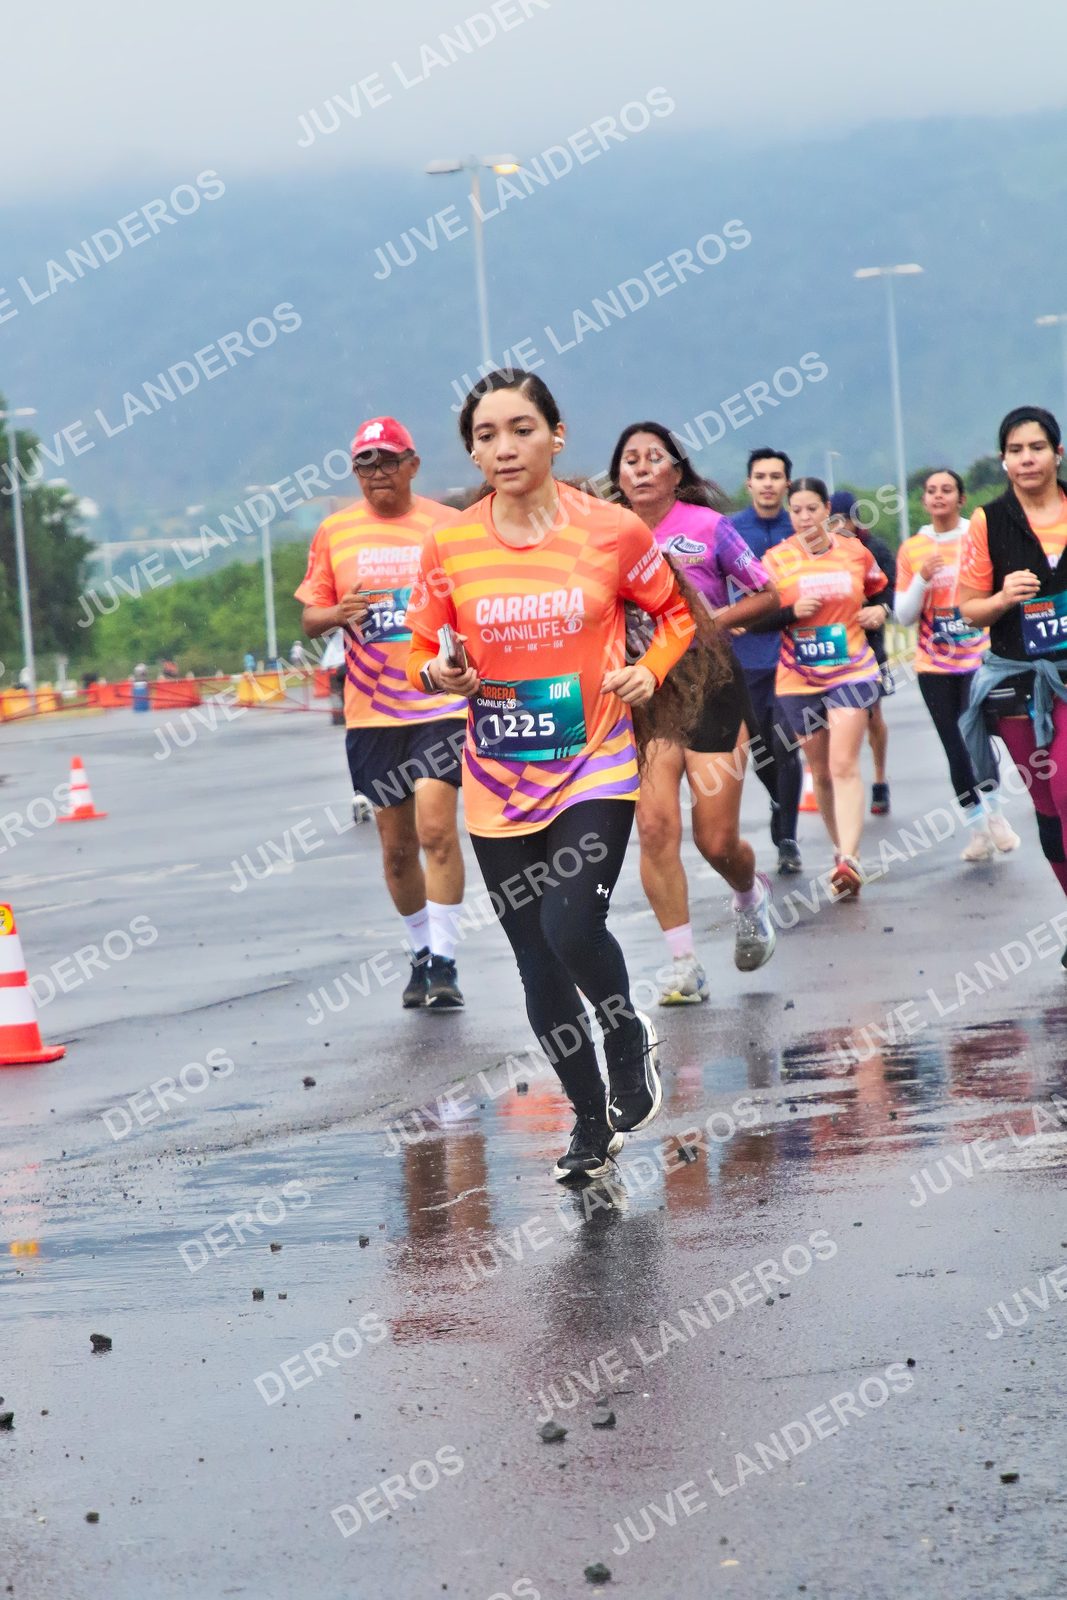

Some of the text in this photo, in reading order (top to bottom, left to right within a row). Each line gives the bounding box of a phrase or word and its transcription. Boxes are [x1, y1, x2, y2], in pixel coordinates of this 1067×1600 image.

[358, 546, 421, 565] CARRER
[476, 587, 584, 625] CARRERA
[371, 611, 406, 629] 126
[940, 619, 969, 632] 165
[1036, 615, 1067, 637] 175
[480, 620, 561, 643] OMNILIFE
[800, 641, 836, 656] 1013
[482, 685, 516, 699] ARRERA
[548, 681, 571, 700] 10K
[489, 713, 556, 737] 1225
